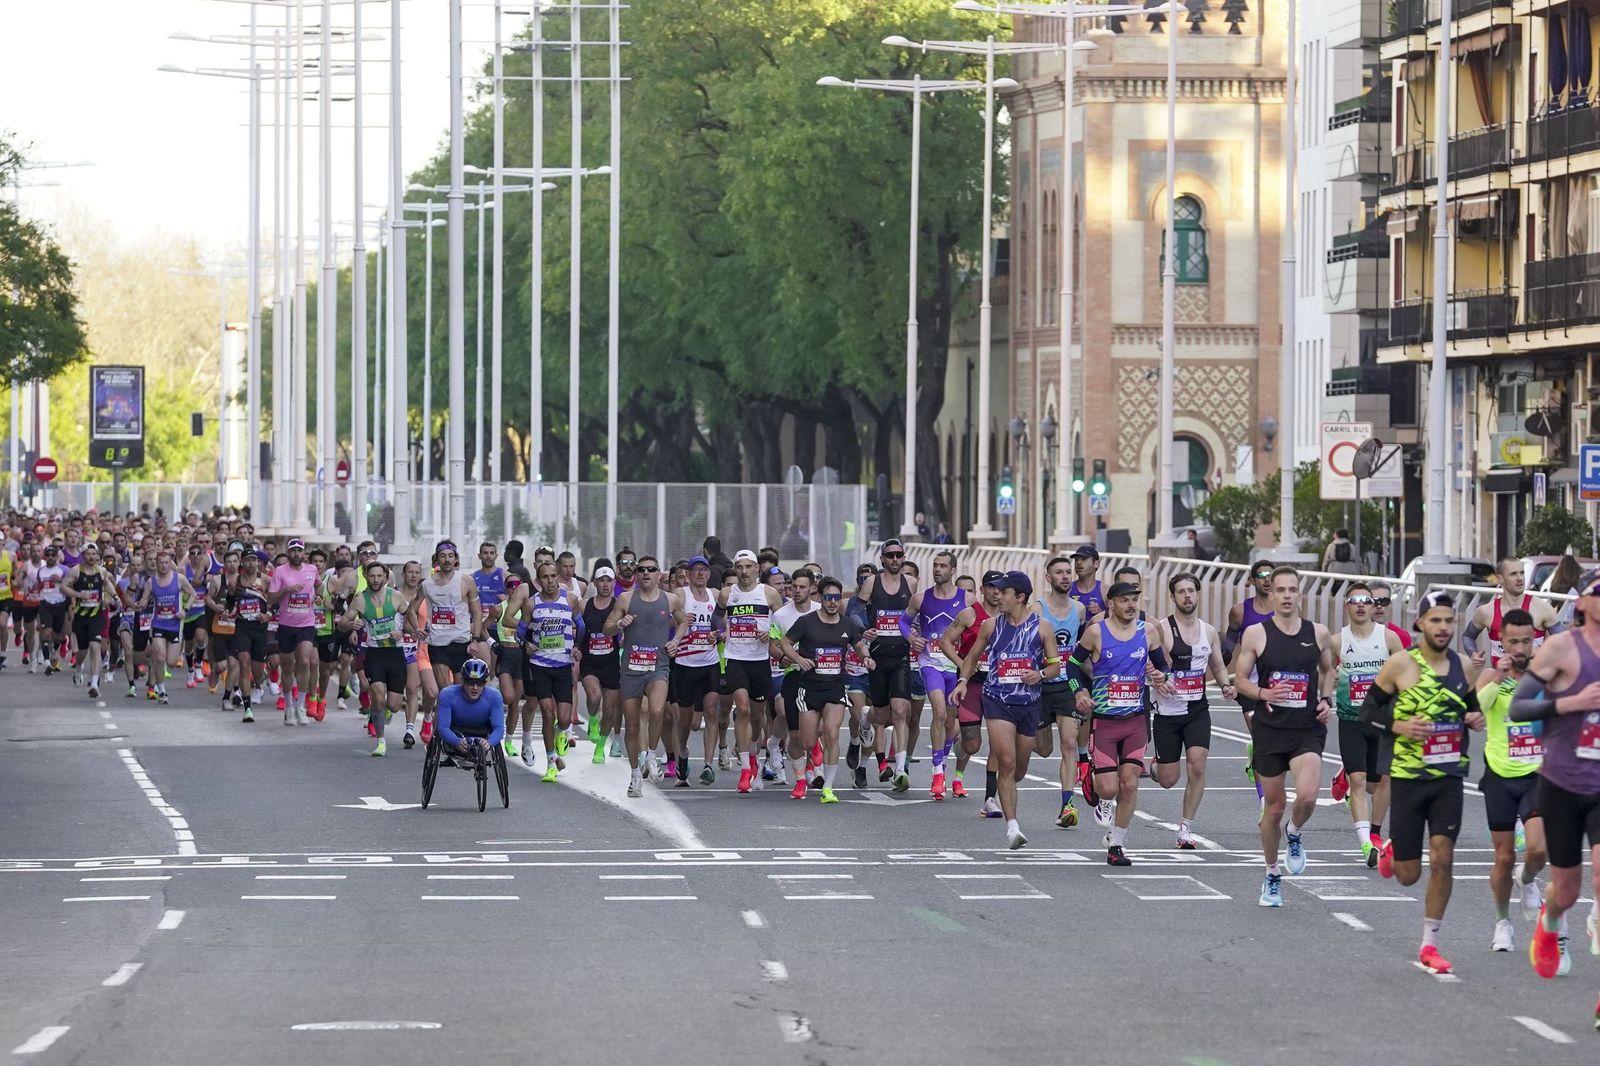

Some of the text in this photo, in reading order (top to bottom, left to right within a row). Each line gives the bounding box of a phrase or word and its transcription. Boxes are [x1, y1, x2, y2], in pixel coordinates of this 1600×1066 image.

[733, 605, 754, 615] ASM
[1287, 691, 1304, 699] ENT
[1436, 723, 1460, 731] ZURICH
[1509, 746, 1532, 755] FRAN
